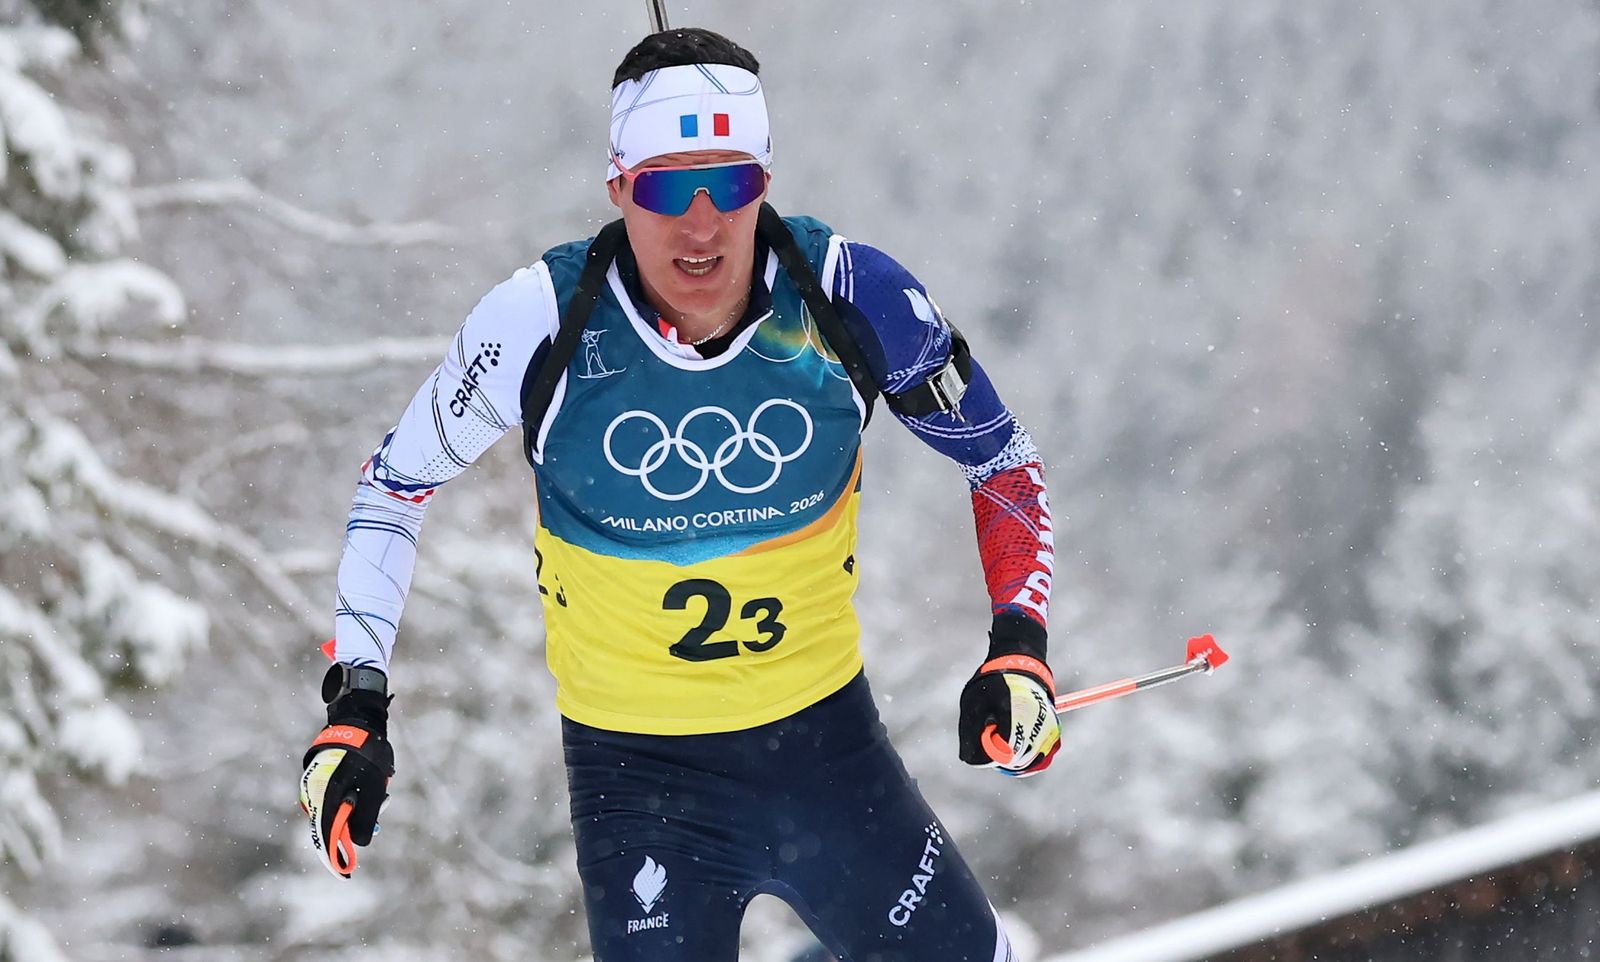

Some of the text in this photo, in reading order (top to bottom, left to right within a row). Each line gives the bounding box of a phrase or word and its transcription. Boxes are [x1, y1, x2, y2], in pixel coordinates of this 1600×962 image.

[449, 353, 488, 418] CRAFT
[600, 490, 825, 532] MILANO CORTINA 2026
[662, 578, 787, 662] 23
[888, 838, 940, 926] CRAFT
[627, 911, 670, 934] FRANCE
